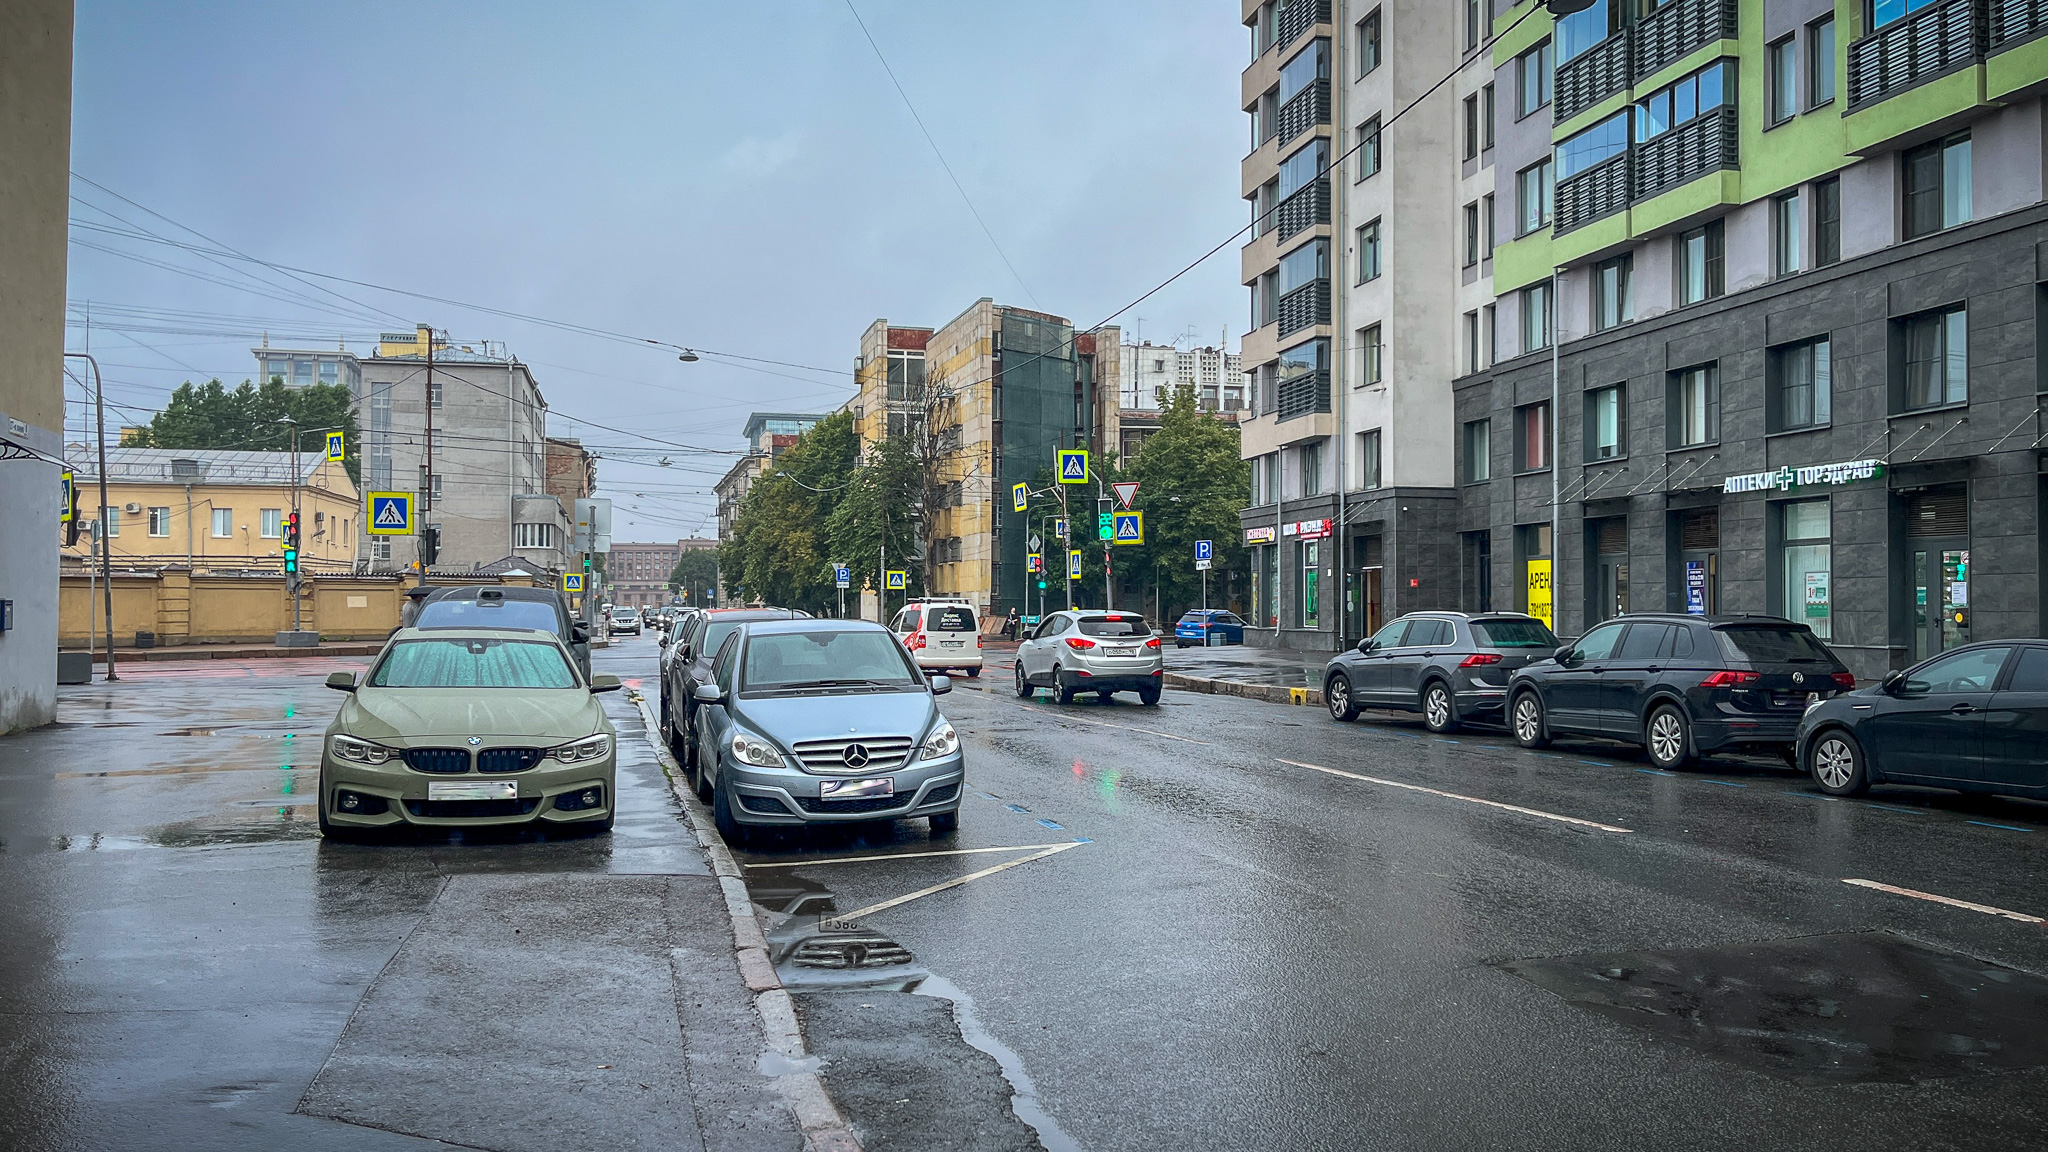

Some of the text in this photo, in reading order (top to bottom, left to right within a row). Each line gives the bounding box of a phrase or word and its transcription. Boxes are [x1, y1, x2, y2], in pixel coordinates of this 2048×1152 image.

[1723, 471, 1777, 494] АПТЕКИ
[1199, 542, 1209, 558] P
[1529, 571, 1551, 592] АРЕН
